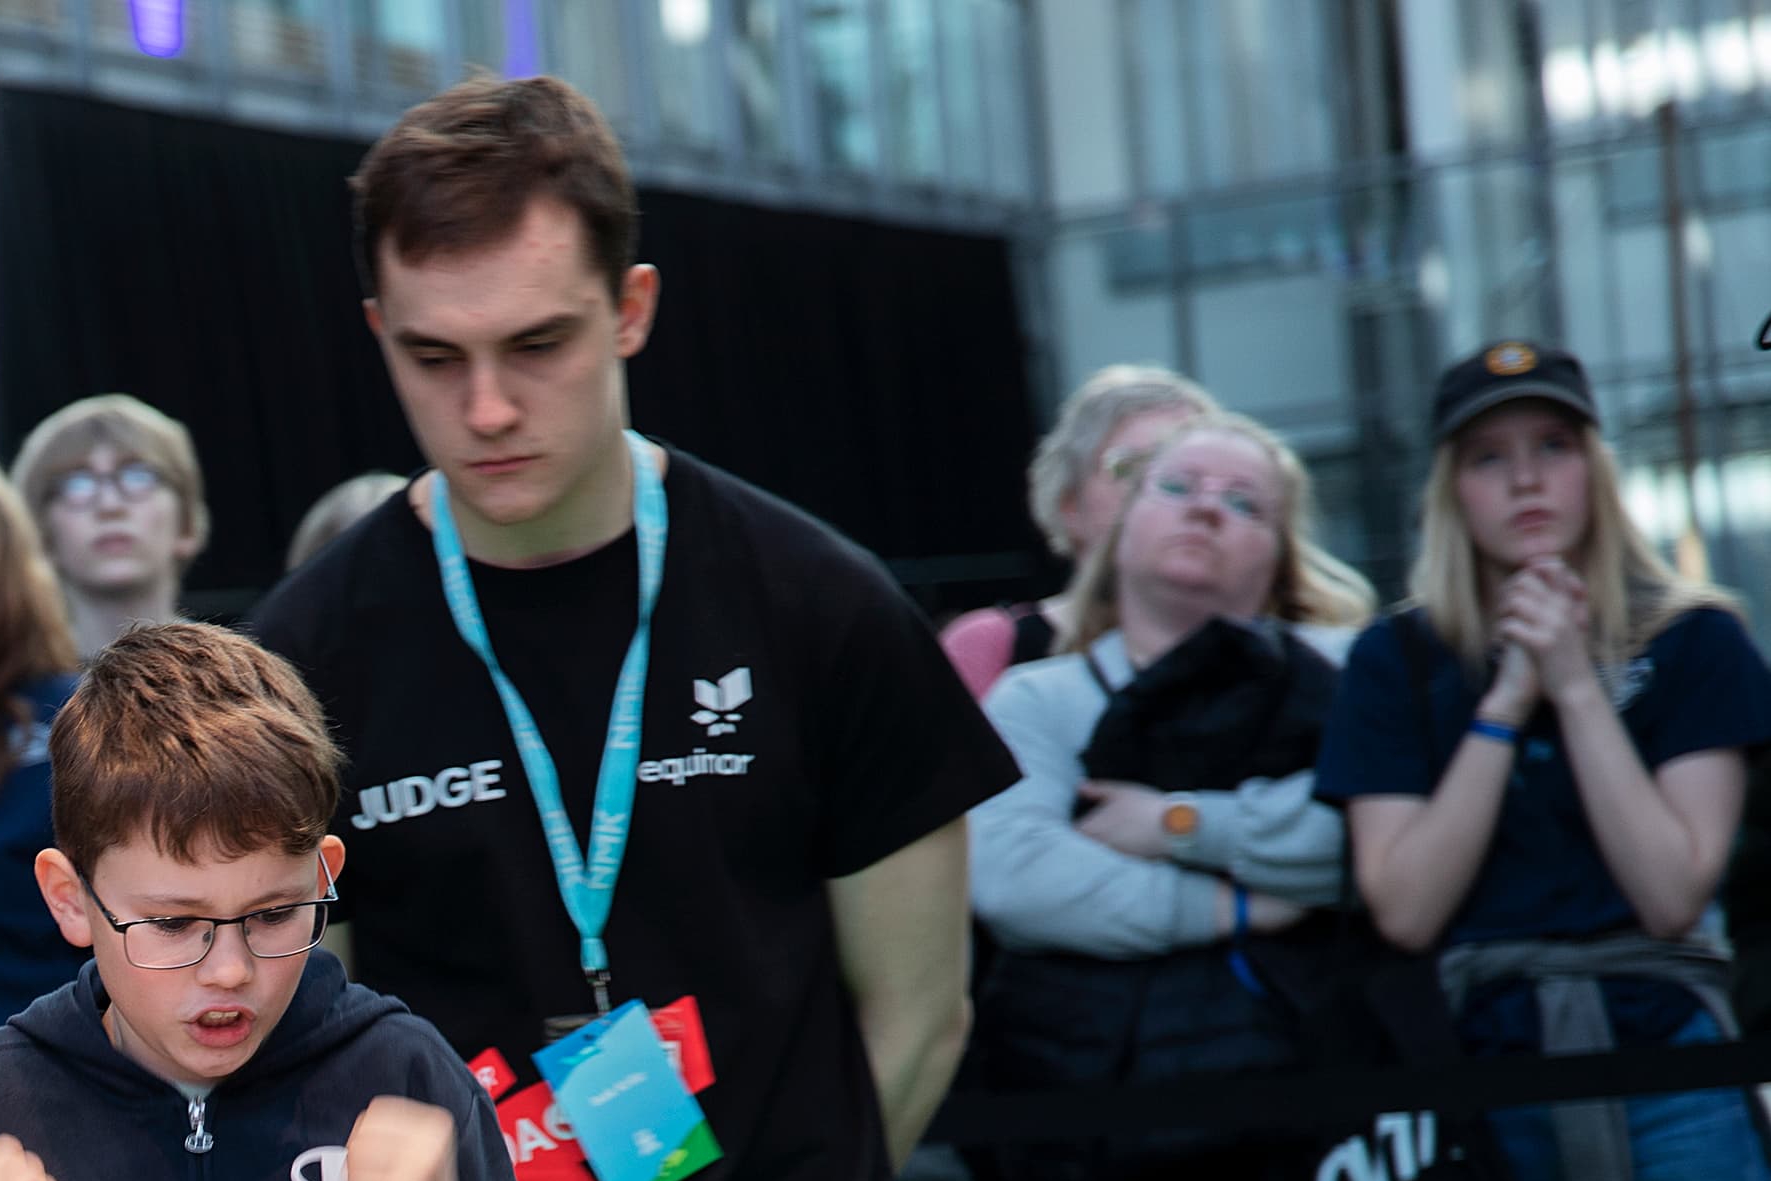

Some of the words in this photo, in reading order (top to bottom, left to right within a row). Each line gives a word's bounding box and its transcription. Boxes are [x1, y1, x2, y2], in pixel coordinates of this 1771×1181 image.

[351, 758, 507, 831] JUDGE
[638, 747, 756, 786] equinor
[586, 809, 627, 890] NMK
